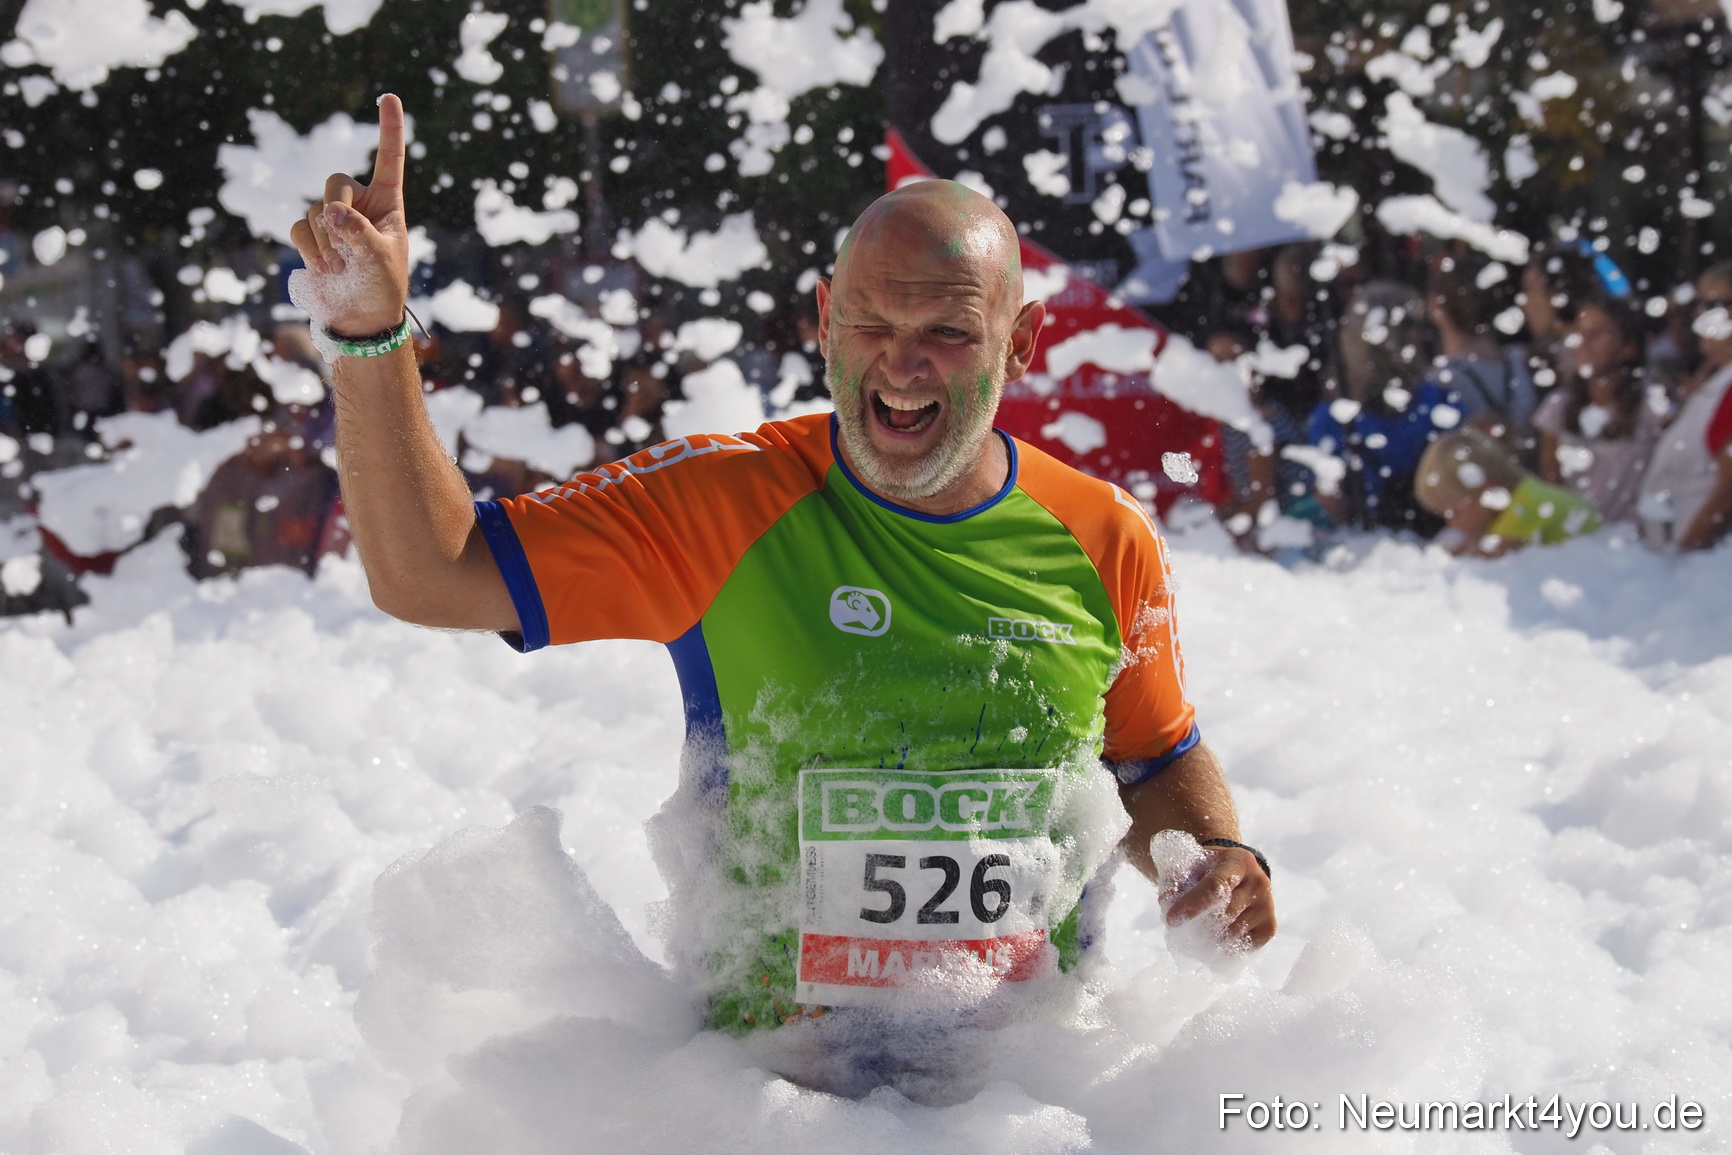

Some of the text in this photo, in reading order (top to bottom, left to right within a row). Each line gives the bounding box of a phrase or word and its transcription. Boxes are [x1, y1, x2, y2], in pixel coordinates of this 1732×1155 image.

[988, 617, 1077, 645] BOCK
[822, 780, 1041, 832] BOCK
[859, 853, 1012, 925] 526
